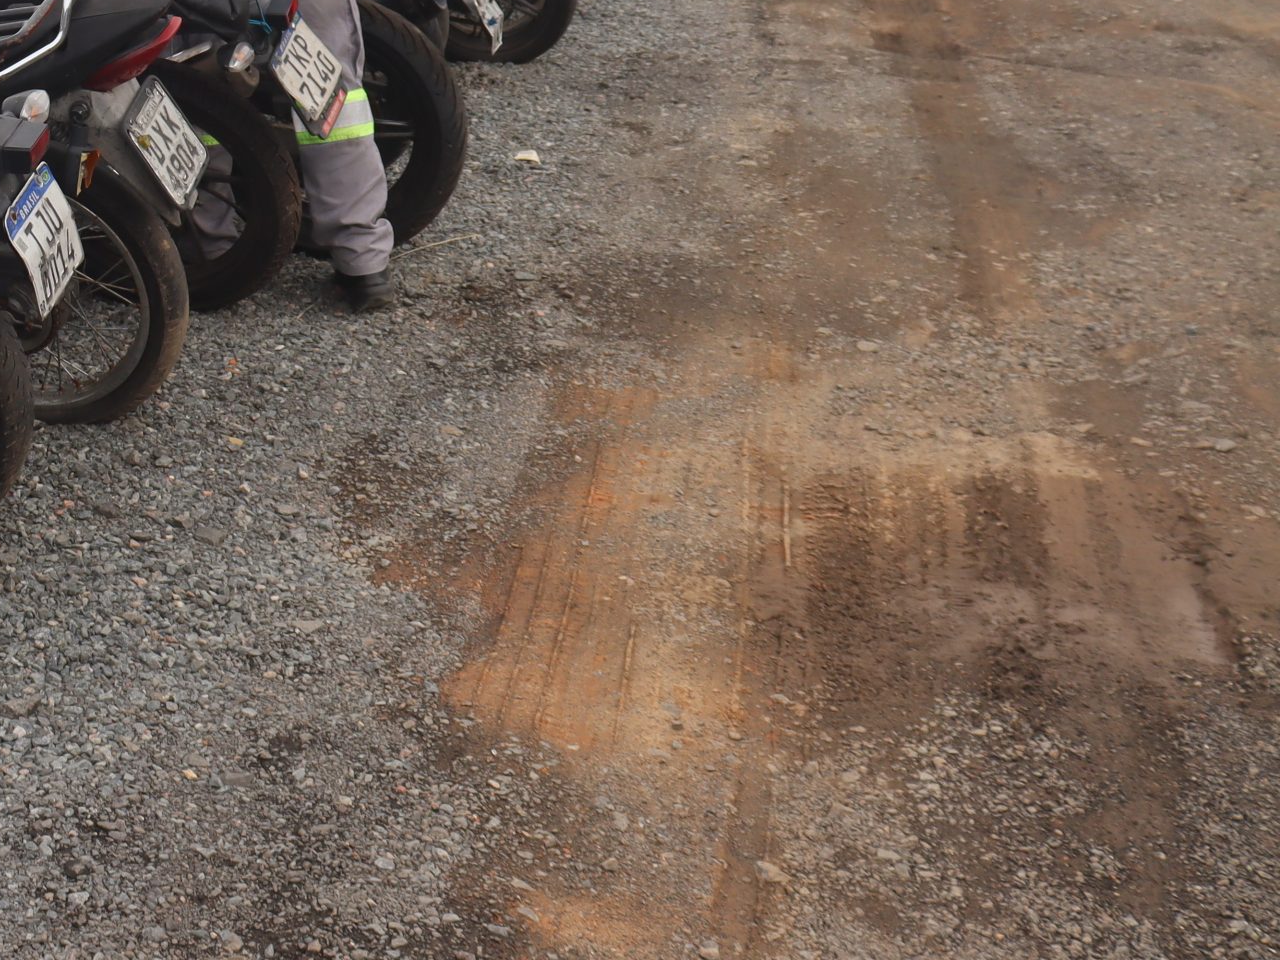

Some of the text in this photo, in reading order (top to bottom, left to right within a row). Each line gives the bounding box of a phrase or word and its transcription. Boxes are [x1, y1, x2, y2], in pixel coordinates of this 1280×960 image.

[283, 34, 313, 78] TKP
[145, 105, 181, 166] DXK
[19, 191, 40, 221] BRASIL
[24, 197, 64, 254] TJU
